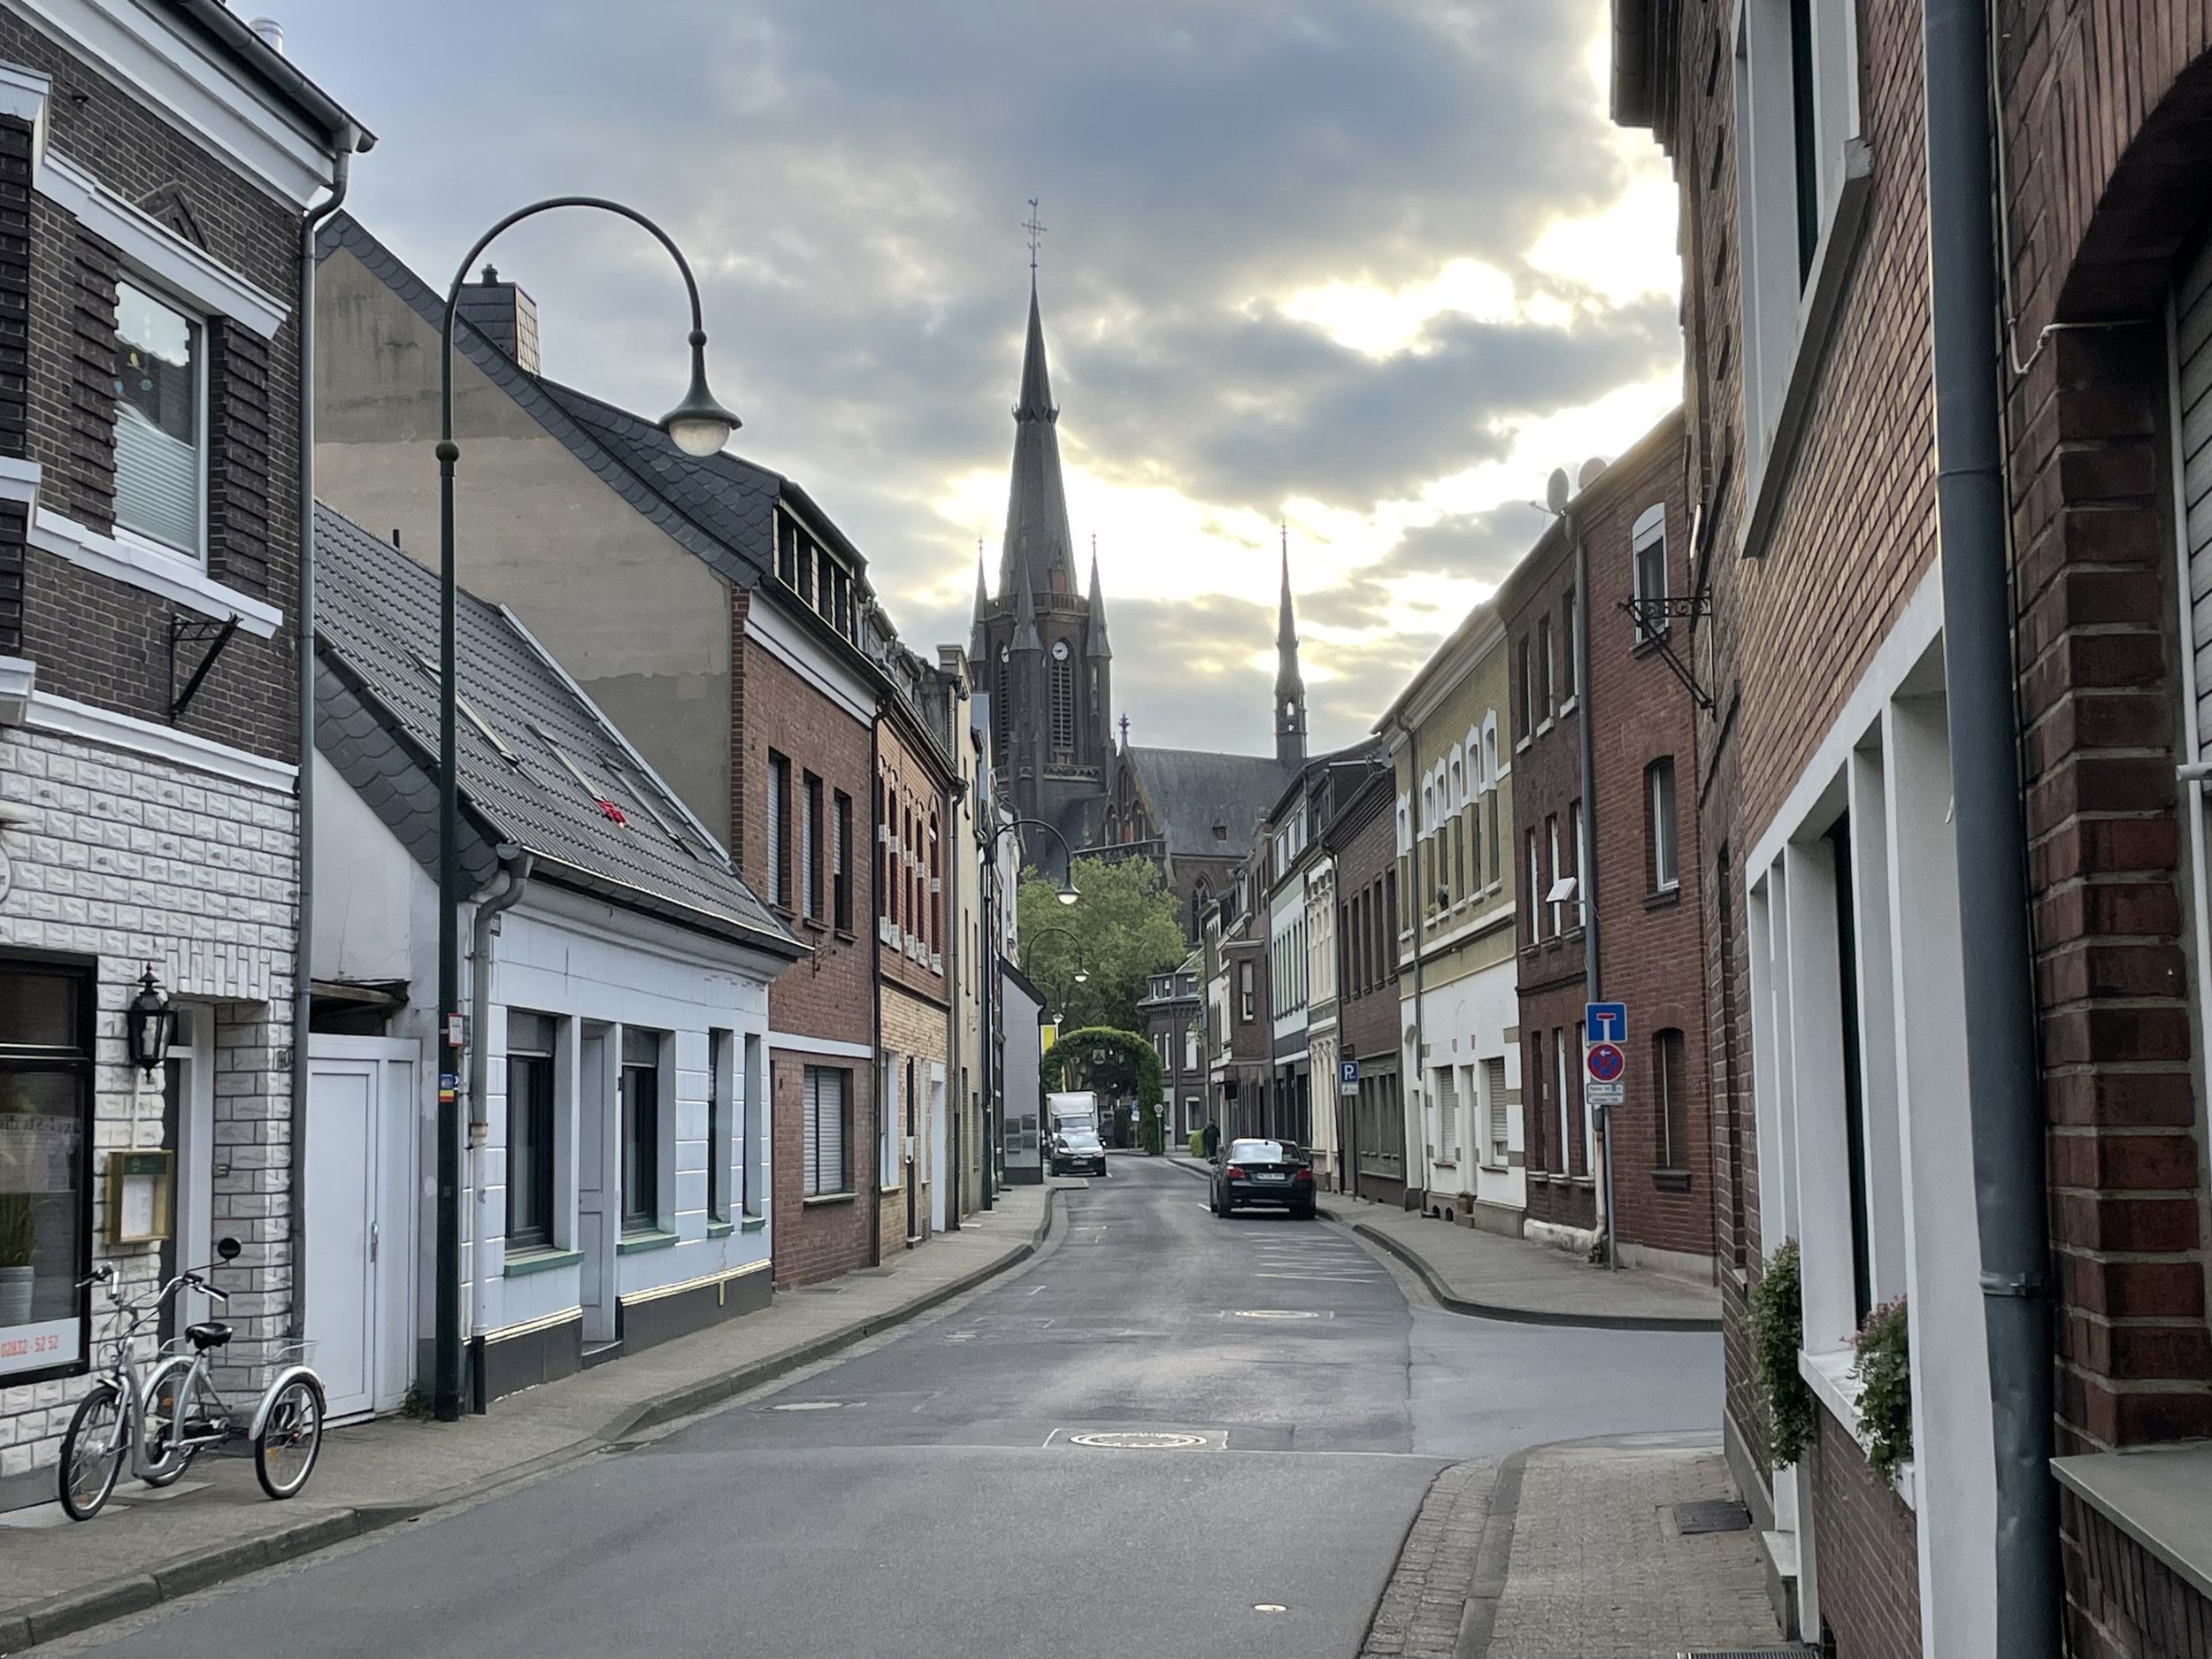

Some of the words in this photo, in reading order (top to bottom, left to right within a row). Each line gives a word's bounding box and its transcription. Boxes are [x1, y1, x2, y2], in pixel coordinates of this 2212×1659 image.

[1344, 1064, 1354, 1080] P
[35, 1336, 45, 1352] 52
[48, 1334, 58, 1350] 52
